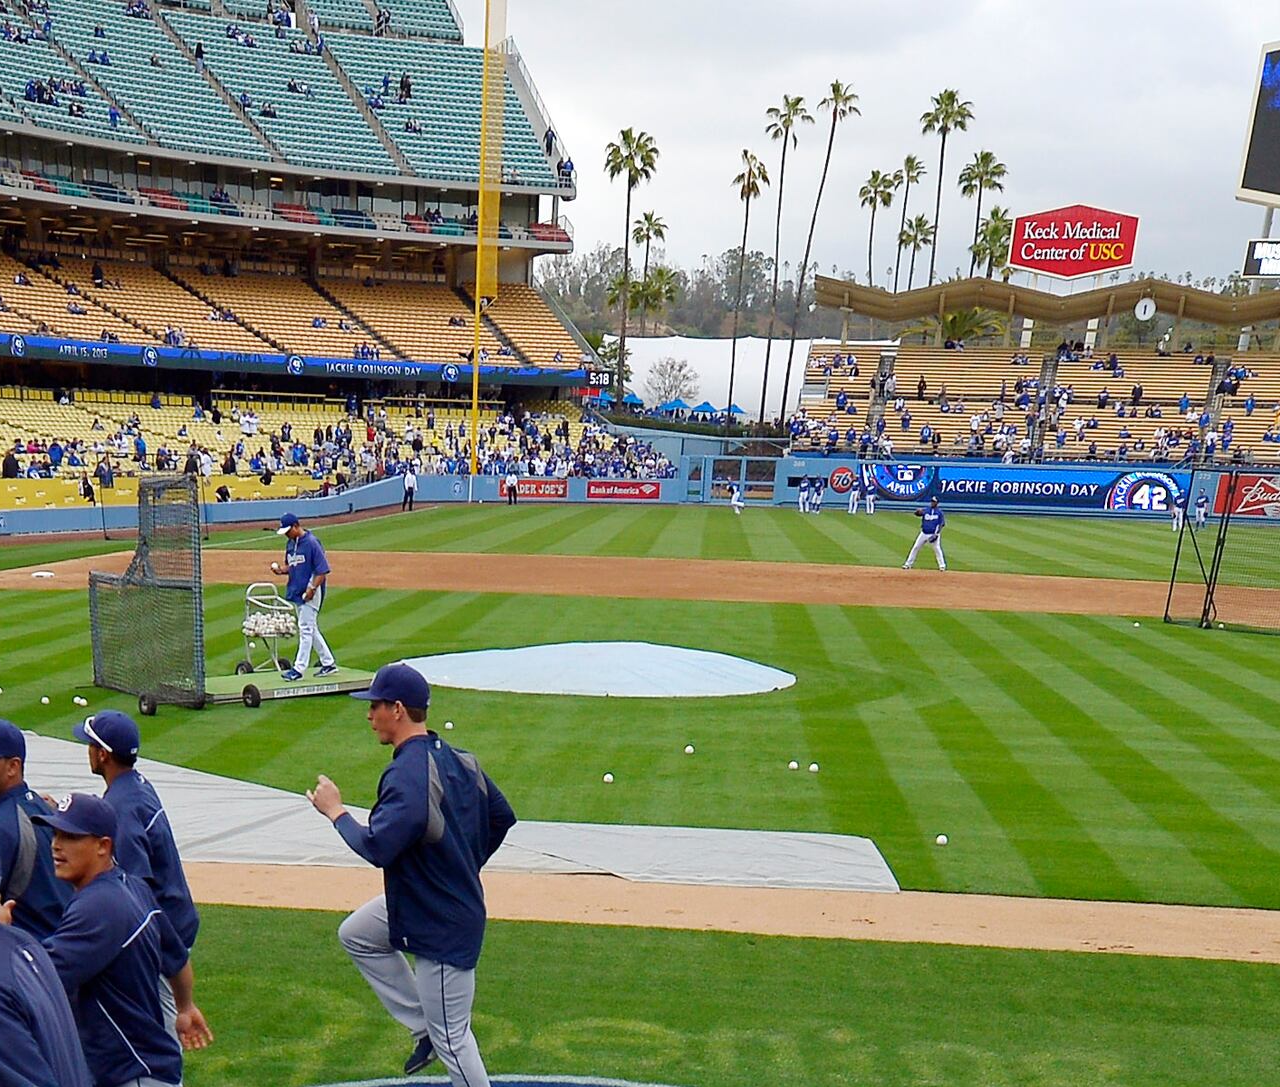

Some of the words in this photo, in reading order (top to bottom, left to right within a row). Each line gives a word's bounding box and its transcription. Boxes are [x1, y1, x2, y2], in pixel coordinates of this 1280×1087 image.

[1022, 221, 1060, 240] Keck
[1062, 221, 1121, 240] Medical
[1021, 242, 1070, 260] Center
[1070, 242, 1088, 260] of
[1089, 242, 1125, 261] USC
[1142, 304, 1148, 315] 1
[326, 362, 355, 374] JACKIE
[357, 364, 402, 375] ROBINSON
[404, 366, 421, 376] DAY
[589, 371, 610, 385] 5:18
[834, 473, 852, 487] 76
[539, 484, 565, 495] JOE'S
[591, 486, 606, 494] Bank
[612, 486, 640, 495] America
[887, 481, 915, 494] APRIL
[941, 480, 987, 493] JACKIE
[992, 481, 1065, 495] ROBINSON
[1070, 484, 1100, 496] DAY
[1132, 484, 1167, 510] 42
